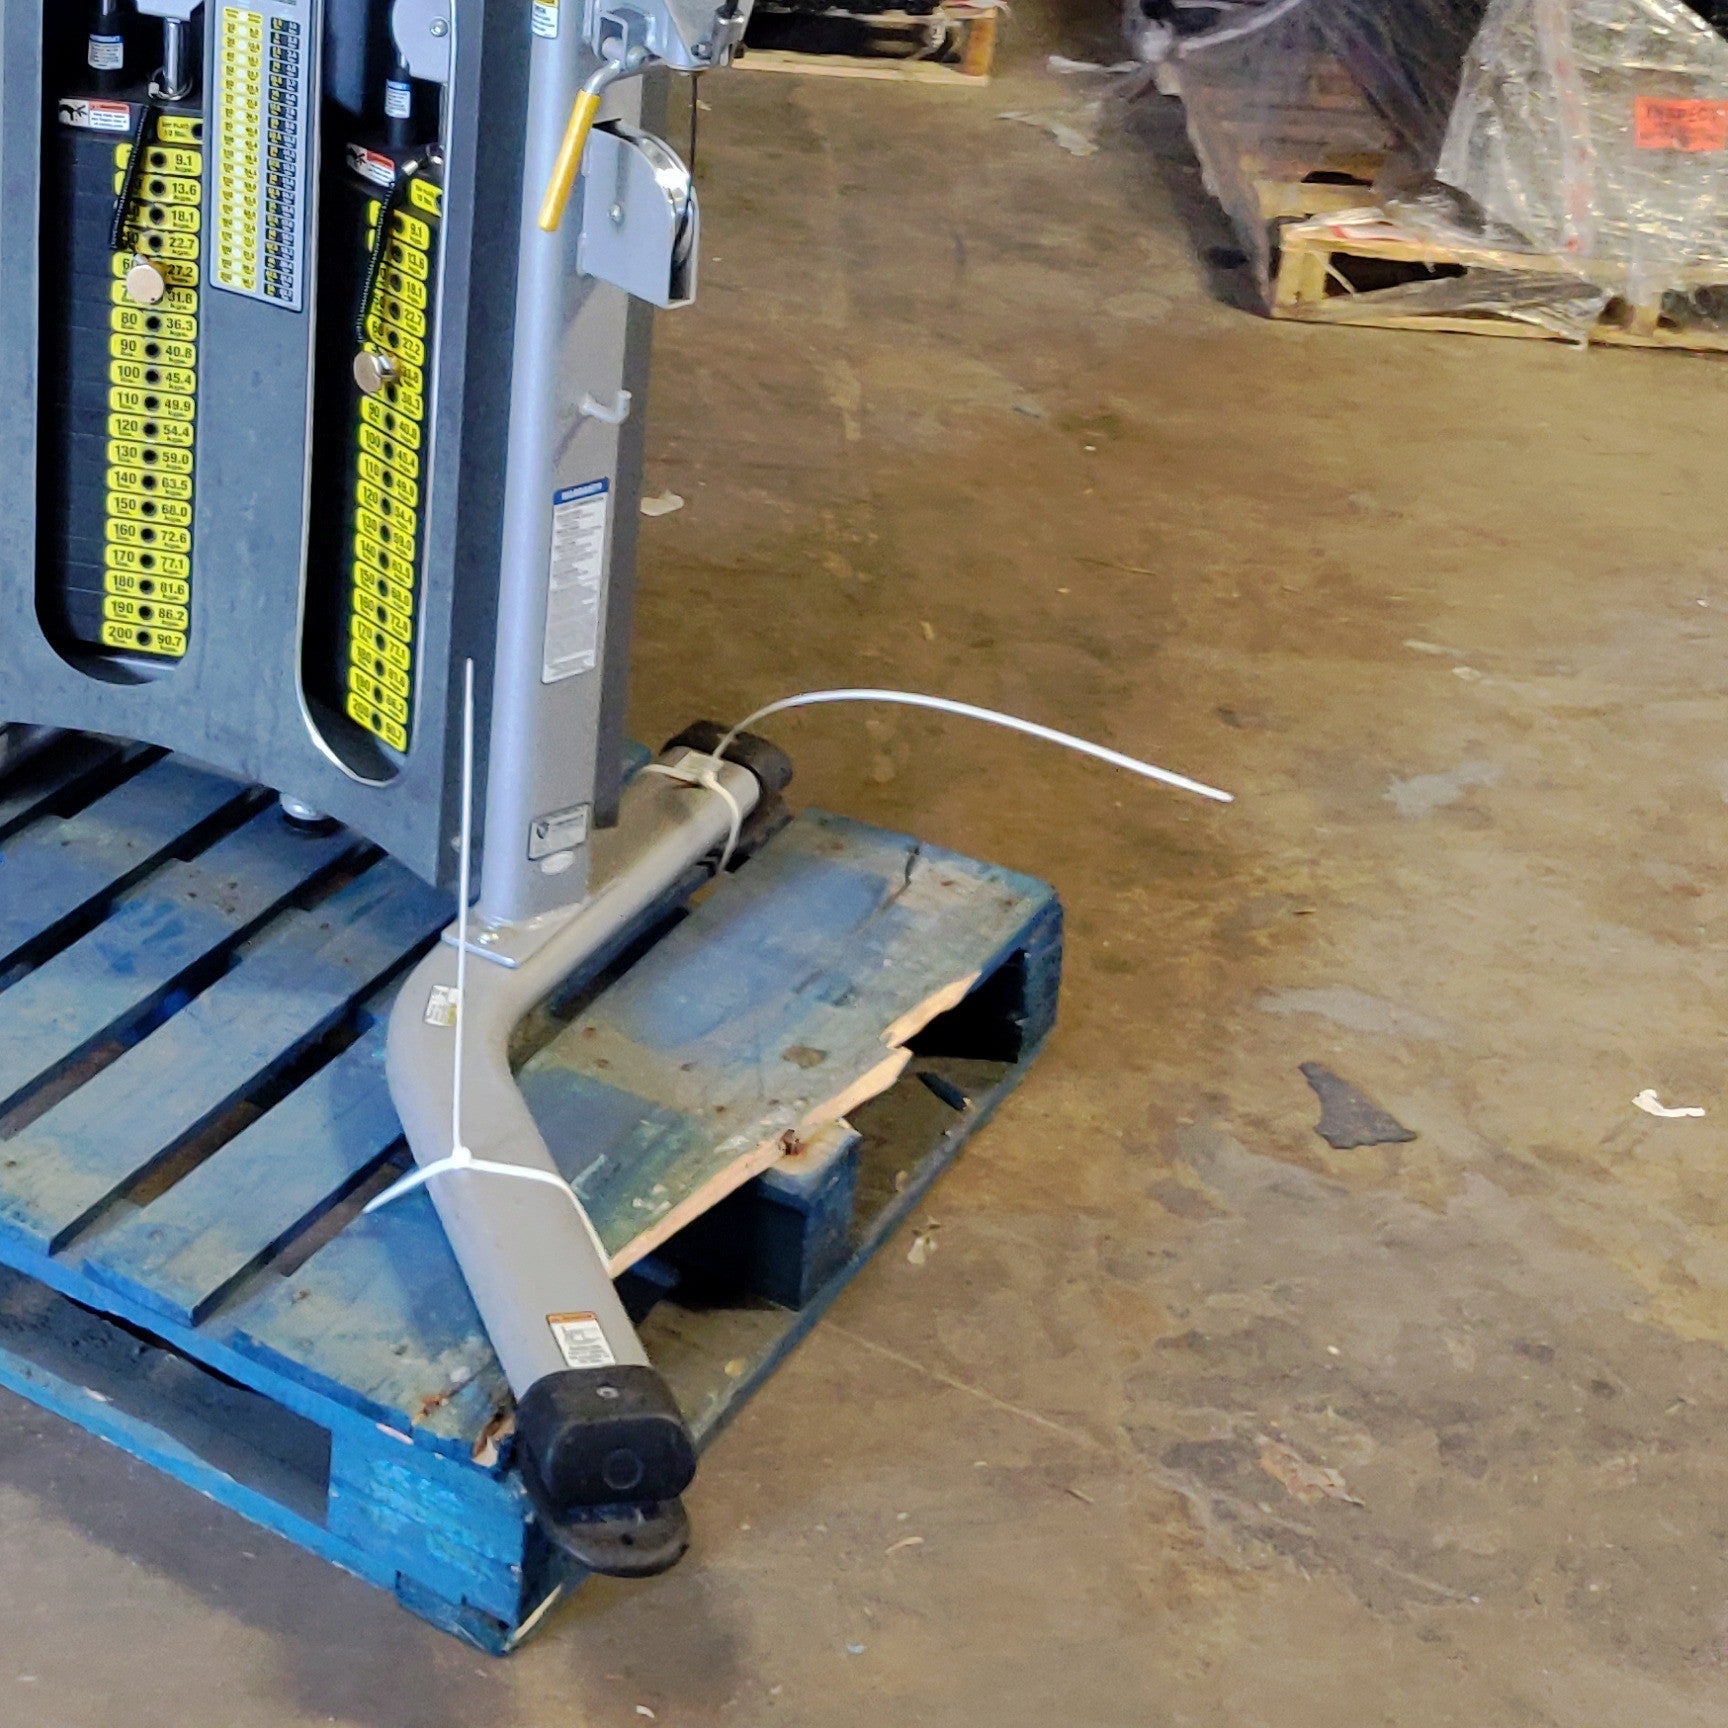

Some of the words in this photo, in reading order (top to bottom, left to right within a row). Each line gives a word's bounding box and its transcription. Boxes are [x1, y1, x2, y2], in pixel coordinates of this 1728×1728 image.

[175, 154, 192, 166] 9.1
[172, 182, 196, 195] 13.6
[172, 210, 194, 223] 18.1
[169, 236, 194, 250] 22.7
[168, 264, 193, 278] 27.2
[121, 312, 138, 325] 80
[166, 318, 193, 331] 36.3
[120, 338, 137, 352] 90
[166, 345, 192, 358] 40.8
[118, 365, 140, 379] 100
[166, 372, 192, 385] 45.4
[118, 391, 138, 405] 110
[164, 398, 190, 412] 49.9
[116, 418, 138, 432] 120
[163, 424, 190, 438] 54.4
[114, 444, 138, 458] 130
[162, 451, 190, 465] 59.0
[114, 470, 137, 484] 140
[114, 496, 136, 510] 150
[114, 523, 136, 536] 160
[160, 529, 187, 544] 72.6
[112, 549, 135, 562] 170
[160, 556, 184, 569] 77.1
[113, 574, 135, 588] 180
[160, 581, 185, 595] 81.6
[112, 600, 134, 614] 190
[108, 626, 133, 639] 200
[157, 634, 182, 647] 90.7
